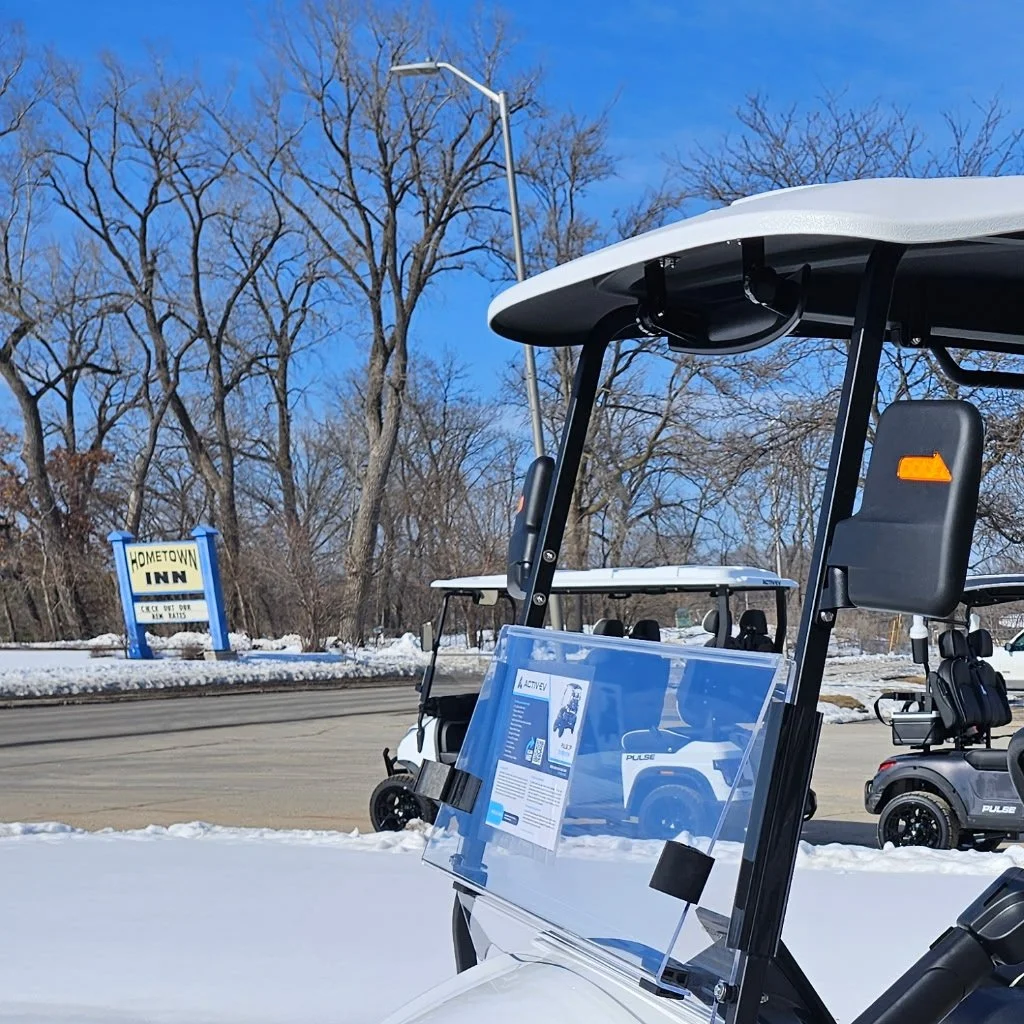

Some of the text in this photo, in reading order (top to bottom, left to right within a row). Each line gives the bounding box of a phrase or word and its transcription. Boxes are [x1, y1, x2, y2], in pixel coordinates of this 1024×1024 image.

[129, 549, 198, 572] HOMETOWN
[146, 571, 187, 585] INN
[982, 805, 1017, 814] PULSE
